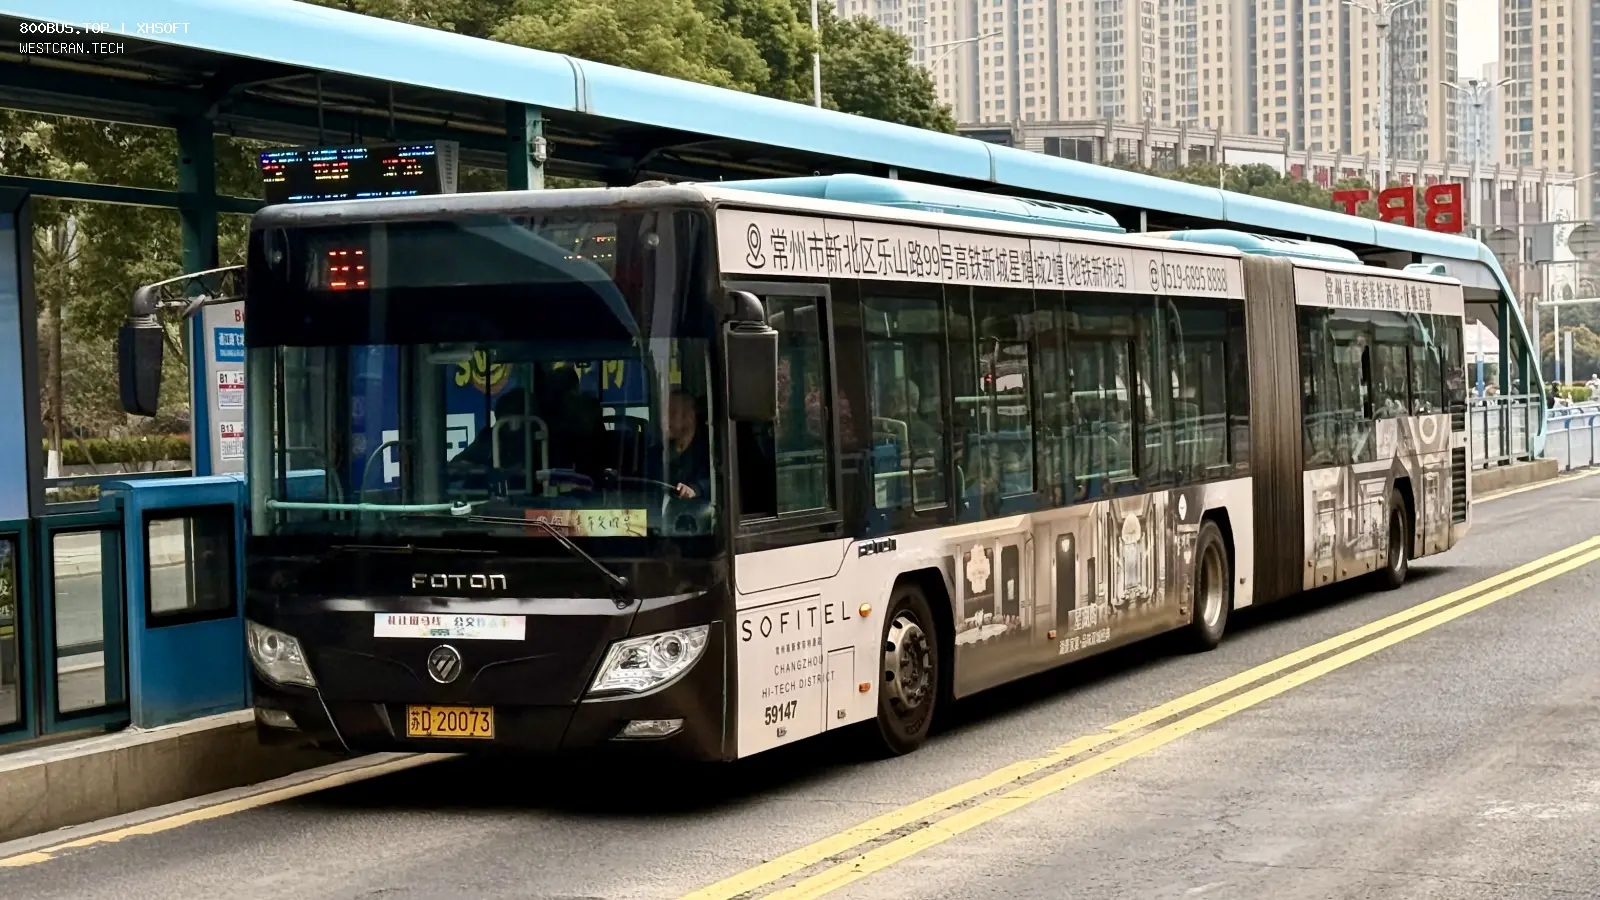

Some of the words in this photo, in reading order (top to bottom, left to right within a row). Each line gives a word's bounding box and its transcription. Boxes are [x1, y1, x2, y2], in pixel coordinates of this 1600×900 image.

[220, 373, 228, 384] B1
[221, 424, 234, 433] B13
[411, 573, 508, 590] FOTON
[741, 600, 851, 642] SOFITEL
[774, 654, 824, 676] CHANGZHOU
[762, 680, 796, 699] HI-TECH
[799, 670, 835, 689] DISTRICT
[764, 699, 798, 726] 59147
